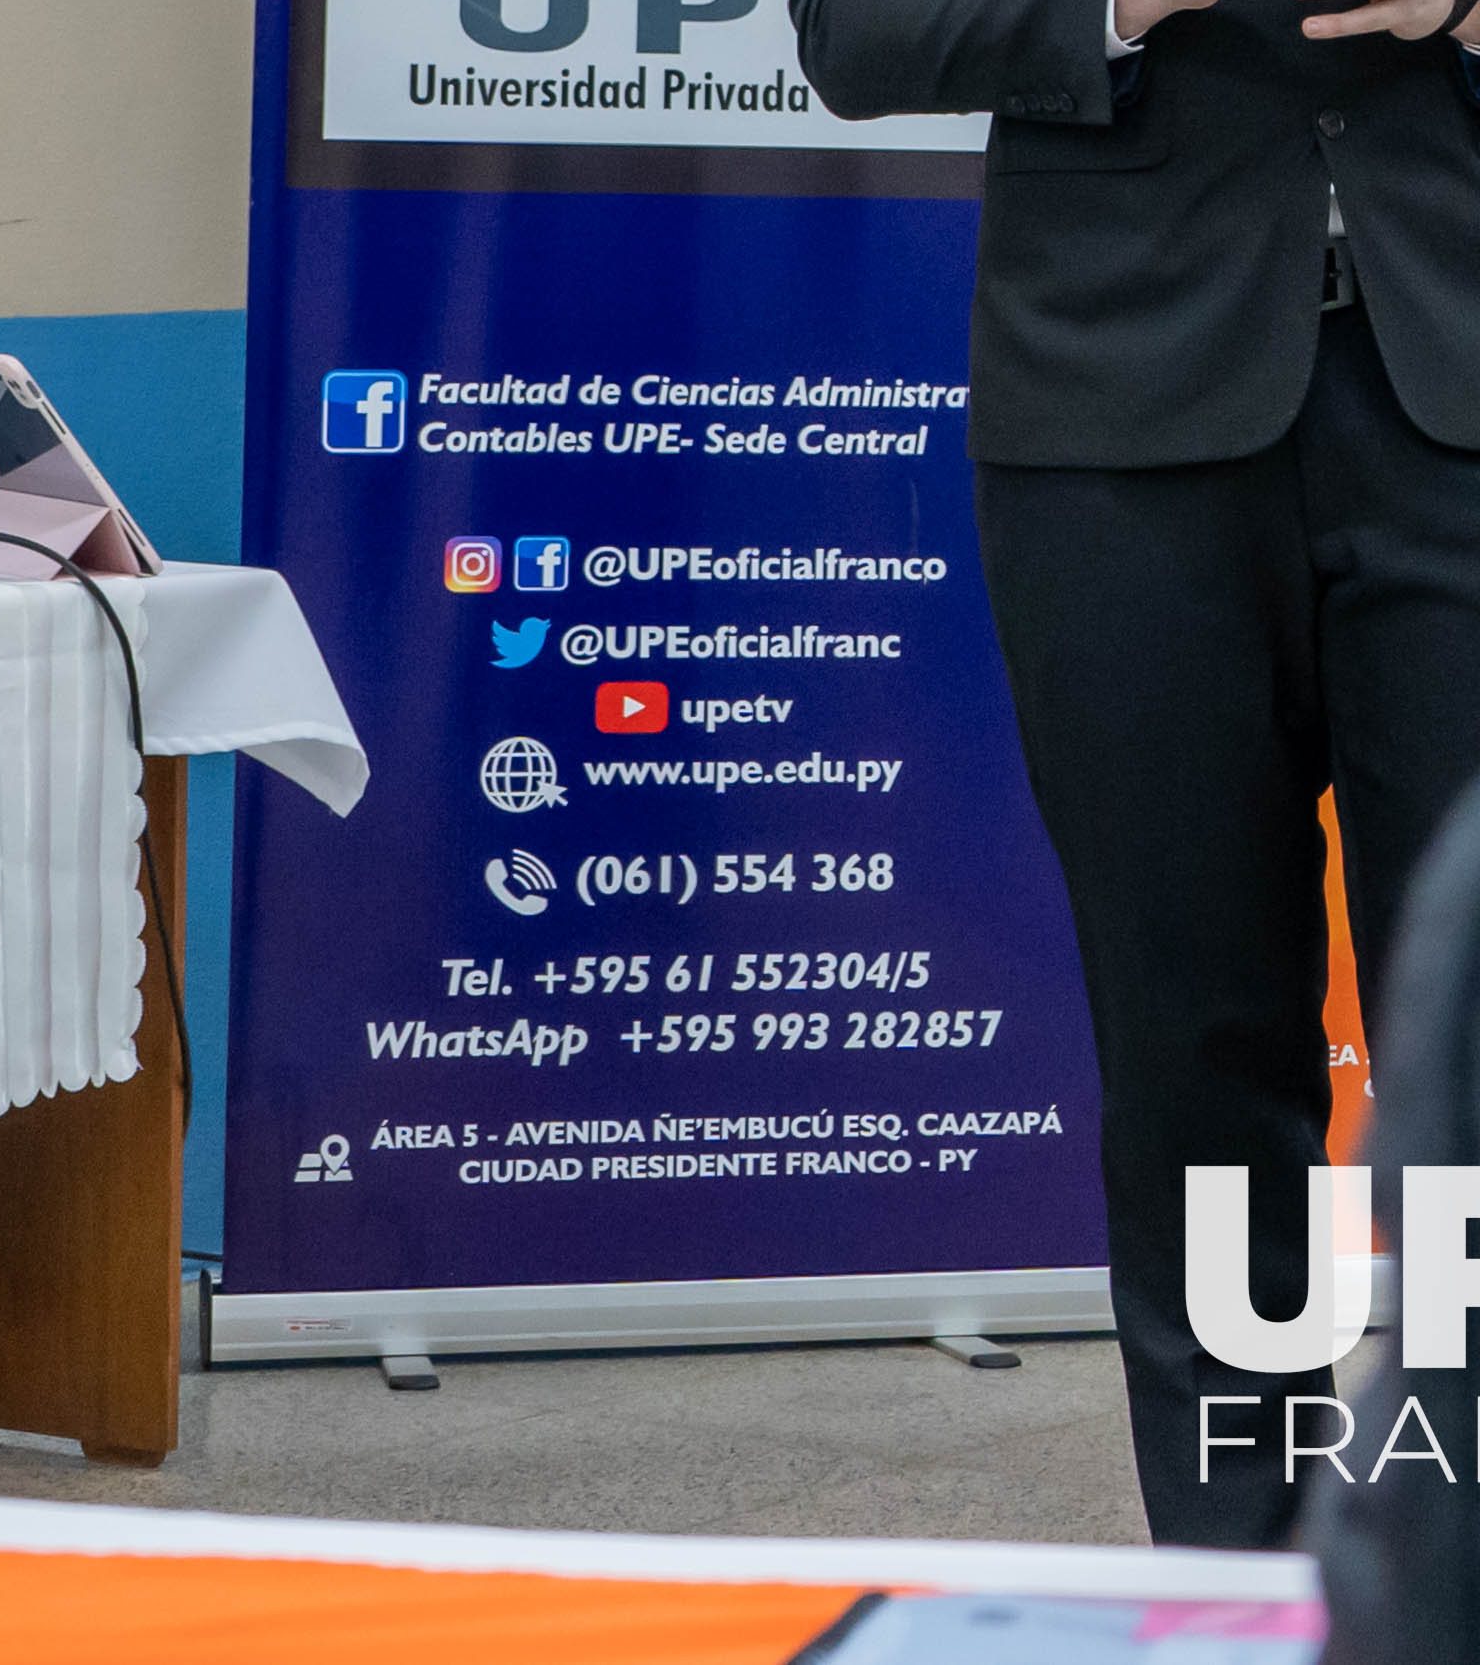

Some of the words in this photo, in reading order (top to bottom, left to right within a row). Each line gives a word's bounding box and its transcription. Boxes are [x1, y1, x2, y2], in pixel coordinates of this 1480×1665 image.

[410, 64, 646, 108] Universidad
[664, 69, 811, 112] Privada
[420, 374, 570, 404] Facultad
[579, 375, 621, 404] de
[632, 375, 775, 406] Ciencias
[783, 377, 968, 408] Administra
[419, 422, 592, 452] Contables
[605, 423, 693, 453] UPE-
[704, 423, 786, 454] Sede
[798, 424, 928, 455] Central
[584, 546, 946, 586] @UPEoficialfranco
[561, 625, 900, 665] @UPEoficialfranc
[682, 695, 793, 732] upetv
[584, 752, 902, 793] www.upe.edu.py
[577, 855, 697, 906] (061)
[714, 854, 796, 892] 554
[812, 853, 893, 891] 368
[442, 959, 512, 996] Tel.
[535, 956, 650, 993] +595
[666, 955, 713, 992] 61
[731, 952, 930, 992] 552304/5
[367, 1019, 588, 1066] WhatsApp
[621, 1015, 736, 1052] +595
[753, 1013, 829, 1050] 993
[844, 1011, 1002, 1048] 282857
[371, 1120, 455, 1149] ÁREA
[463, 1124, 478, 1147] 5
[654, 1109, 834, 1141] ÑE’EMBUCÚ
[843, 1114, 908, 1140] ESQ.
[918, 1105, 1062, 1136] CAAZAPÁ
[460, 1158, 582, 1183] CIUDAD
[592, 1153, 776, 1179] PRESIDENTE
[786, 1150, 911, 1174] FRANCO
[939, 1149, 977, 1171] PY
